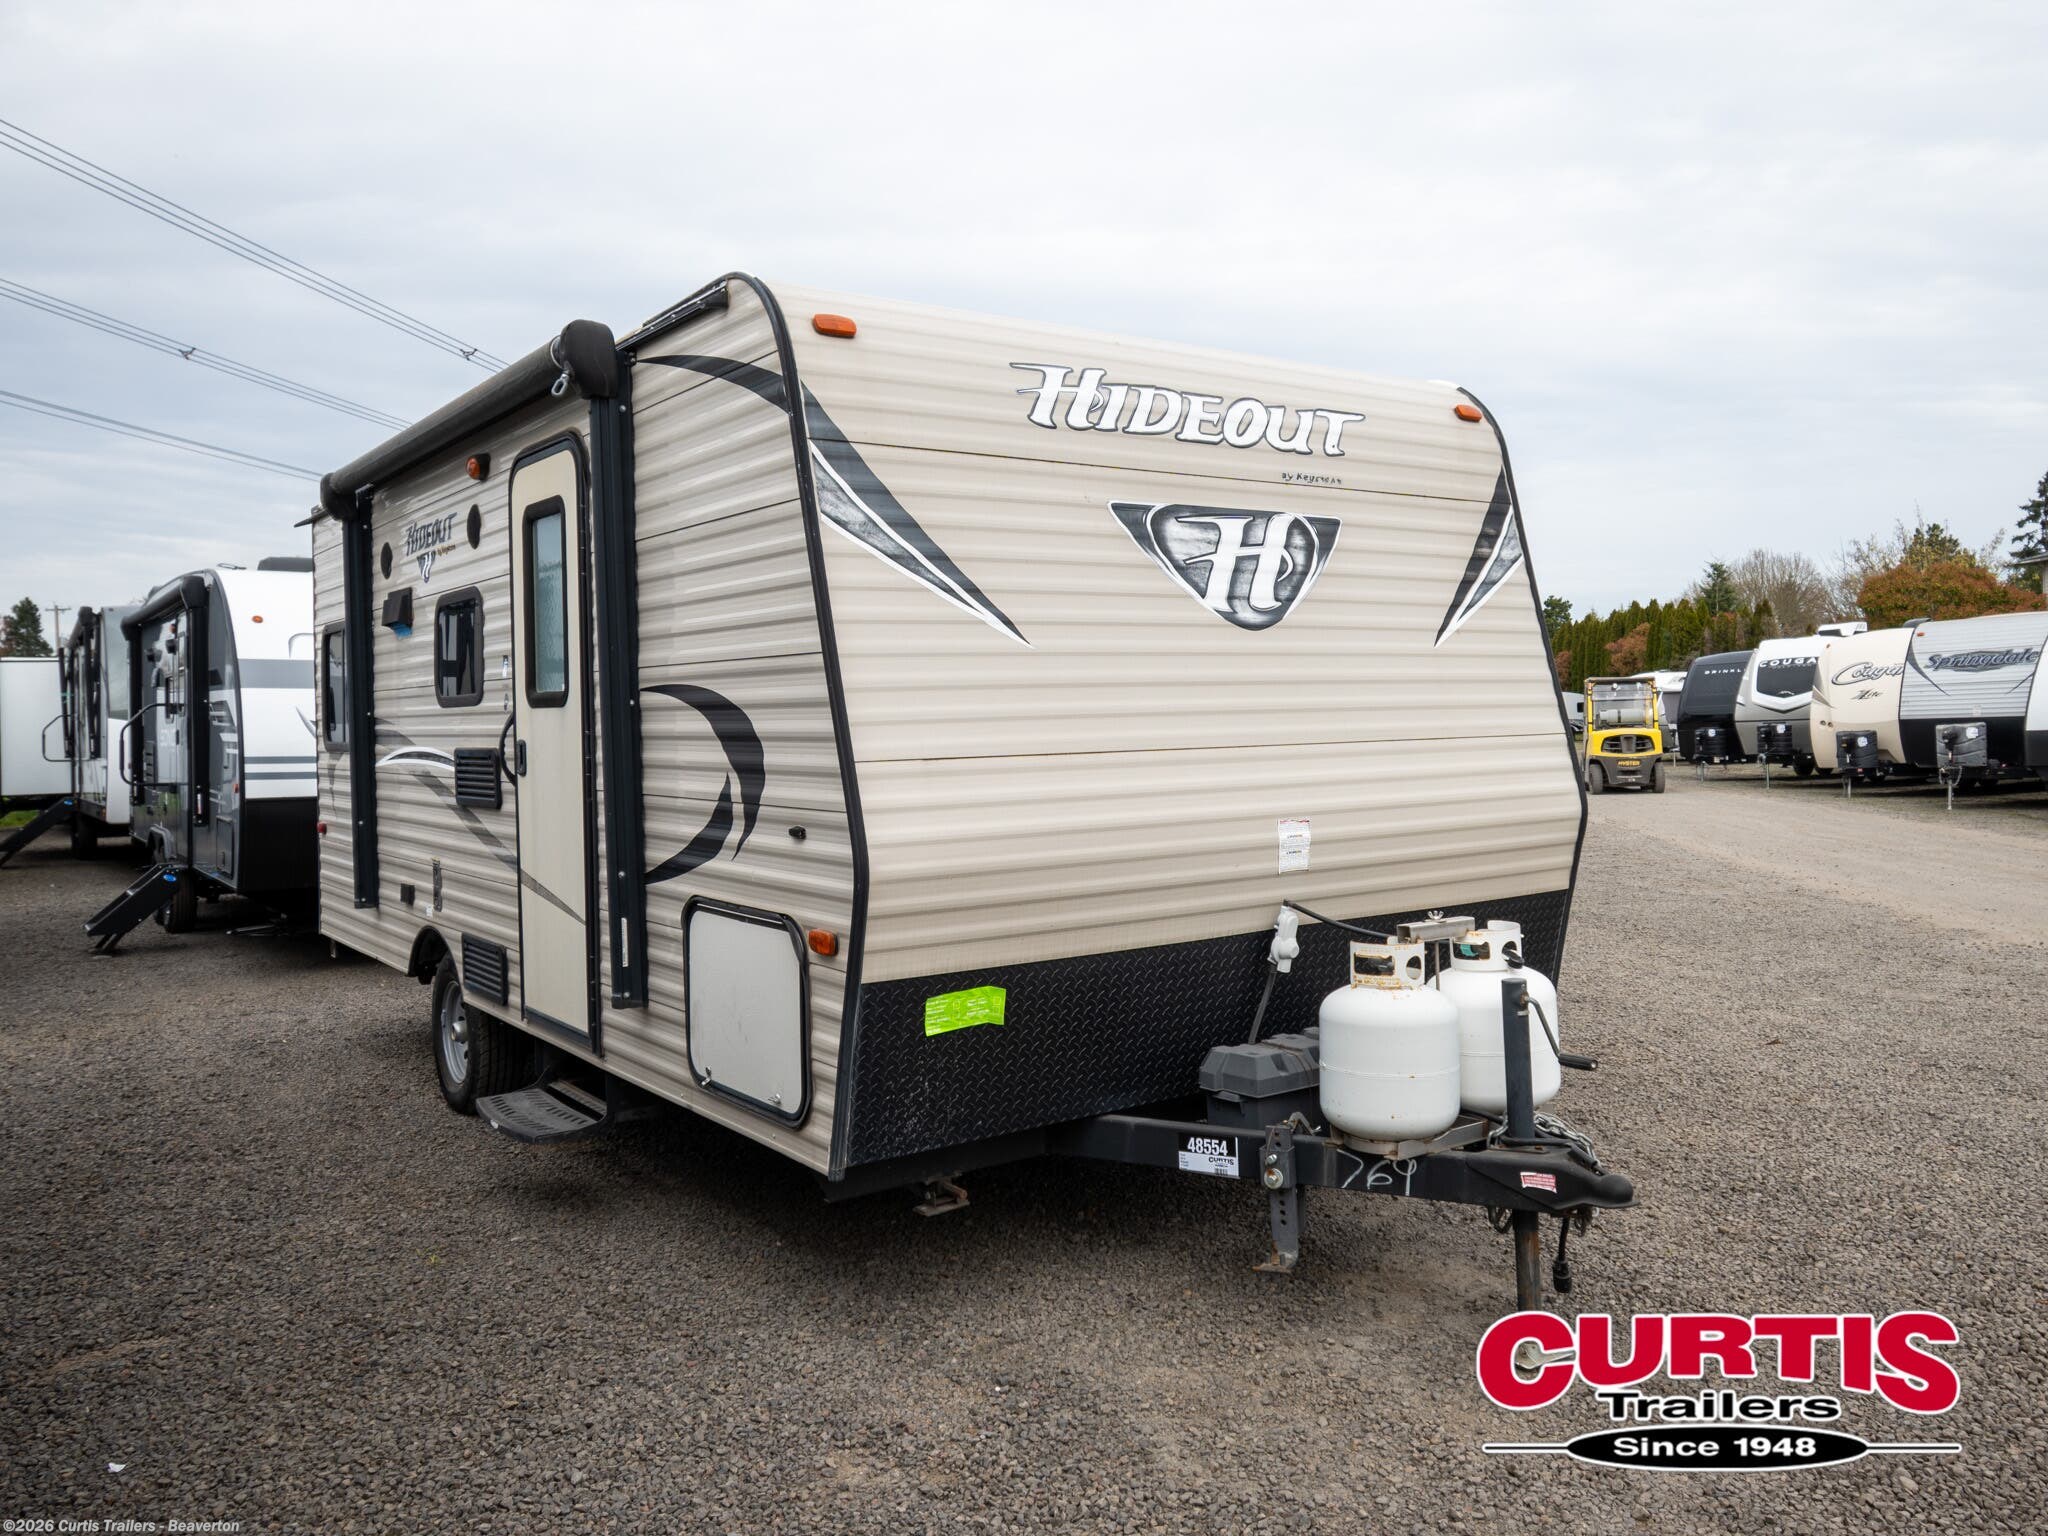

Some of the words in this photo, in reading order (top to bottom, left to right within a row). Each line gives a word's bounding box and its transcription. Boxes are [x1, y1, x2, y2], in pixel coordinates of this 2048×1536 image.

[1009, 362, 1366, 457] HIDEOUT
[404, 512, 458, 556] HIDEOUT
[1759, 657, 1818, 668] COUGA
[1928, 648, 2040, 671] Springdale
[1831, 661, 1904, 685] Couga
[1187, 1137, 1228, 1156] 48554
[1208, 1156, 1235, 1166] CURTIS
